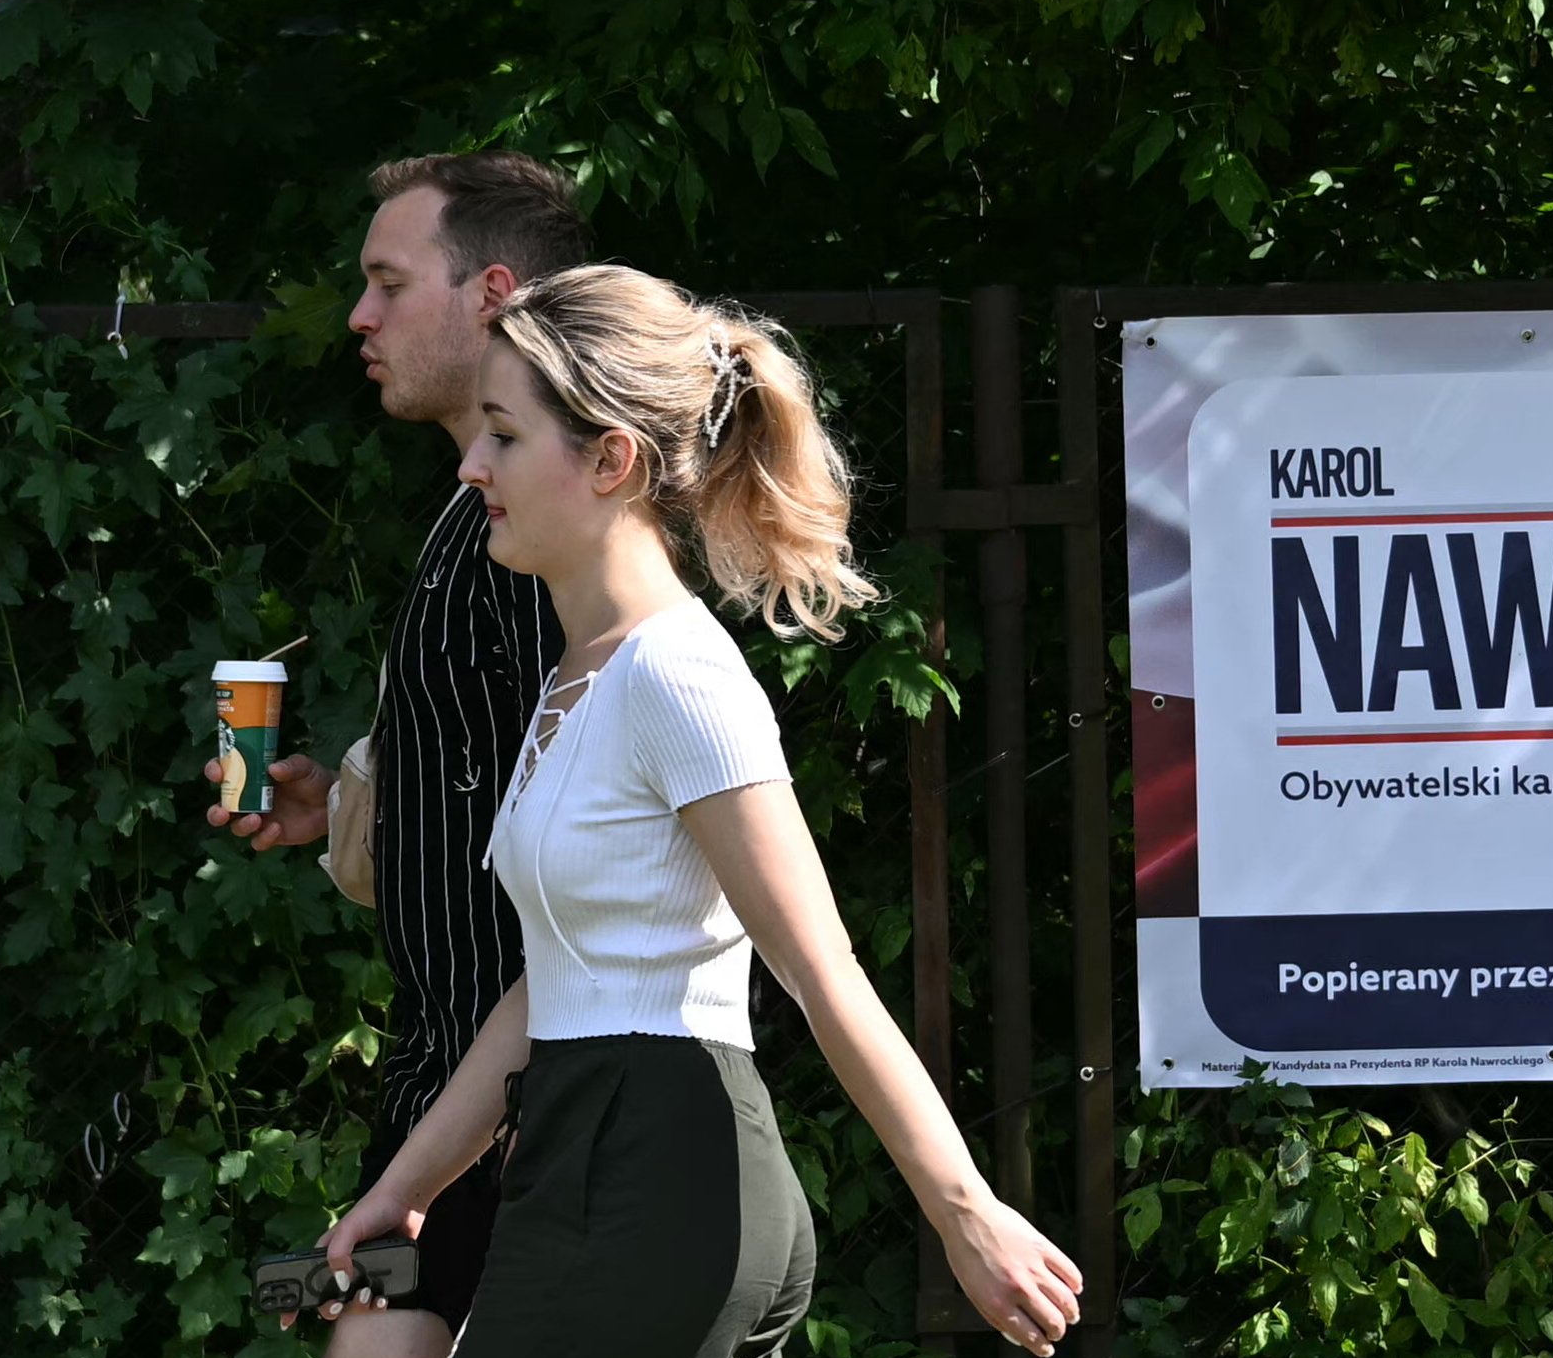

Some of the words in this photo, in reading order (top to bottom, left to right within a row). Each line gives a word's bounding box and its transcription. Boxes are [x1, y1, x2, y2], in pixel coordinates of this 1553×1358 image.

[1270, 446, 1395, 499] KAROL
[1280, 766, 1500, 808] Obywatelski
[1279, 961, 1460, 1001] Popierany
[1202, 1062, 1244, 1072] Materia
[1272, 1061, 1331, 1072] Kandydata
[1349, 1057, 1412, 1071] Prezydenta
[1415, 1058, 1429, 1067] RP
[1432, 1057, 1467, 1067] Karola
[1471, 1056, 1544, 1067] Nawrockiego
